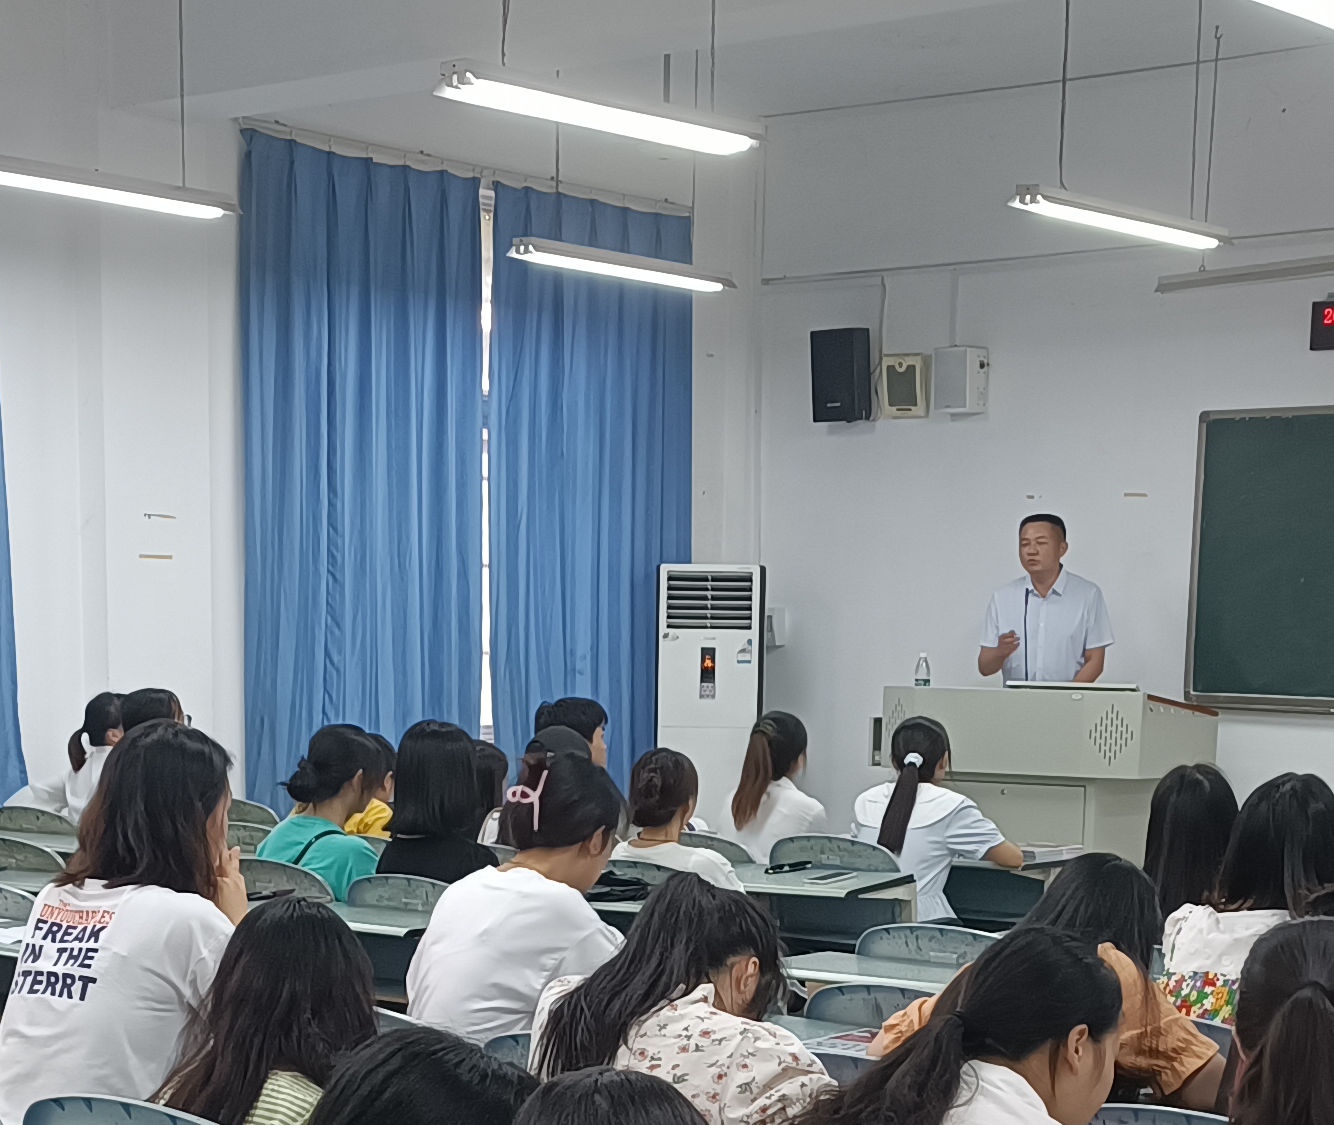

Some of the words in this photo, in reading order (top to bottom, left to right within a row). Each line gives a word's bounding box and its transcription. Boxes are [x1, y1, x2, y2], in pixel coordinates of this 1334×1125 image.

[30, 917, 109, 944] FREAK
[21, 942, 45, 965] IN
[52, 946, 100, 969] THE
